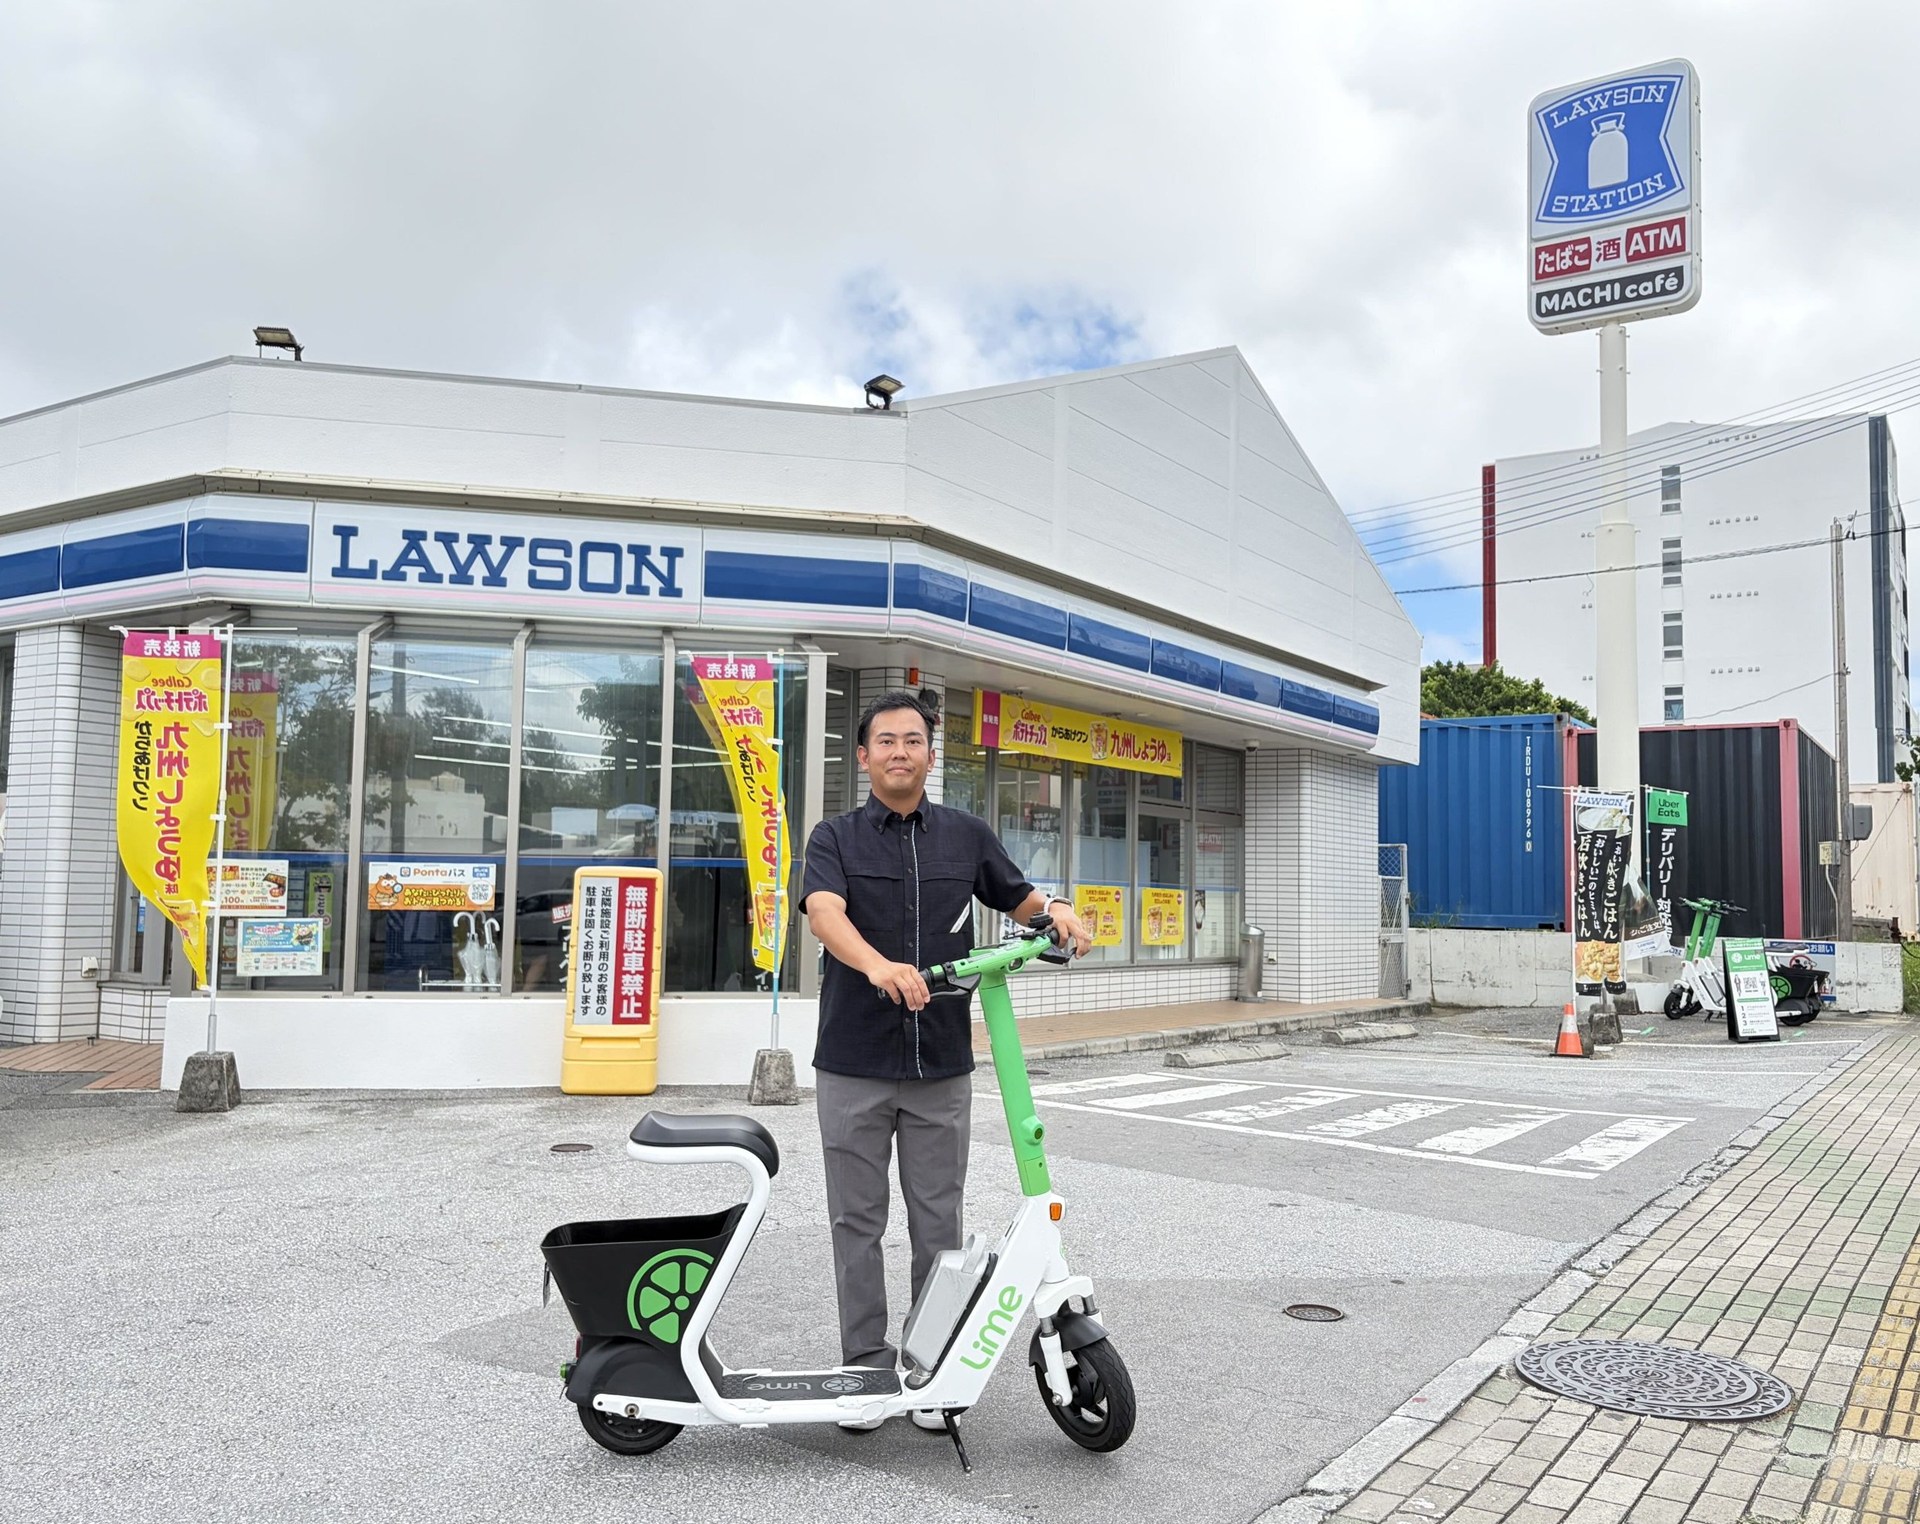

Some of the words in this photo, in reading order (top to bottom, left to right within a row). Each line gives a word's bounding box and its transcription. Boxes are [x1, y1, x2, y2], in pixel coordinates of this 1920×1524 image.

[1550, 85, 1667, 129] LAWSON
[1552, 173, 1666, 213] STATION
[1538, 244, 1590, 275] たばこ
[1595, 236, 1621, 264] 酒
[1628, 223, 1682, 257] ATM
[1540, 281, 1621, 314] MACHI
[1624, 271, 1679, 299] café
[331, 524, 684, 598] LAWSON
[1012, 719, 1048, 747] ポテトチップス
[1020, 708, 1042, 724] Calbee
[1051, 724, 1089, 745] からあげクン
[1577, 796, 1624, 807] LAWSON
[1657, 808, 1681, 818] Eats
[1658, 798, 1680, 808] Uber
[580, 886, 597, 1016] 駐車は固くお断り致します
[595, 885, 613, 1016] 近隣施設ご利用のお客様の
[619, 885, 649, 1019] 無断駐車禁止
[959, 1285, 1023, 1369] Lime
